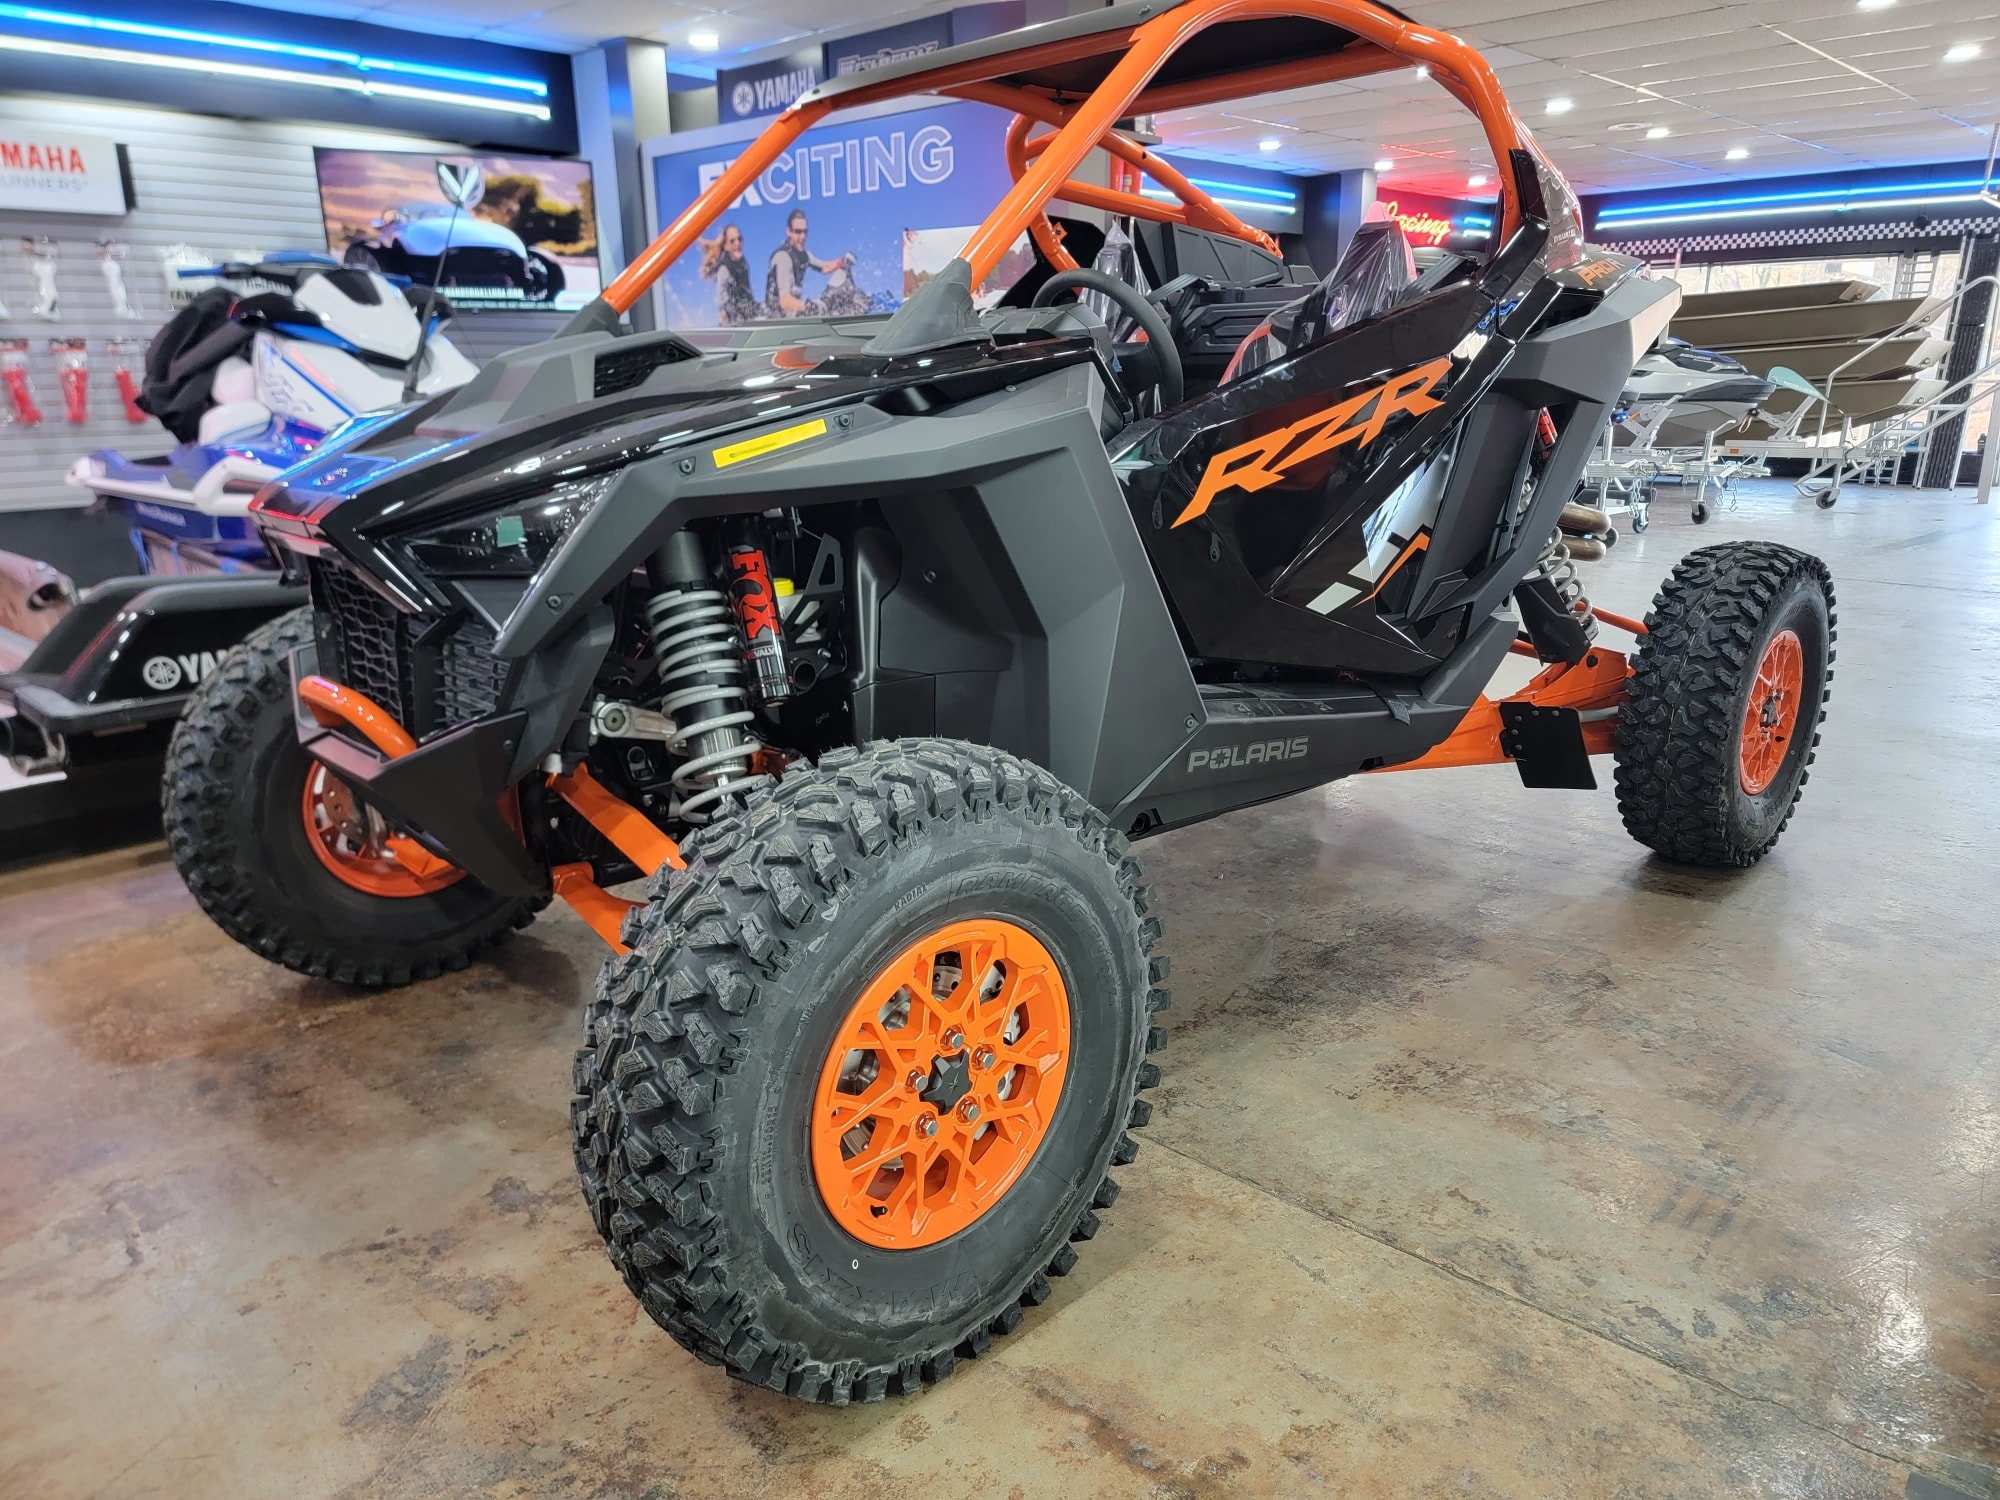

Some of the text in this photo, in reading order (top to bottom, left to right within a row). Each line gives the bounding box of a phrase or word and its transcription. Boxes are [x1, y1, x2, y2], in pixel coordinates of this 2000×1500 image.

[755, 67, 816, 110] YAMAHA
[1170, 357, 1453, 529] RZR
[731, 549, 782, 640] FOX
[1187, 736, 1309, 773] POLARIS
[894, 883, 928, 912] RADIAL
[955, 870, 1089, 923] RAMPAGE
